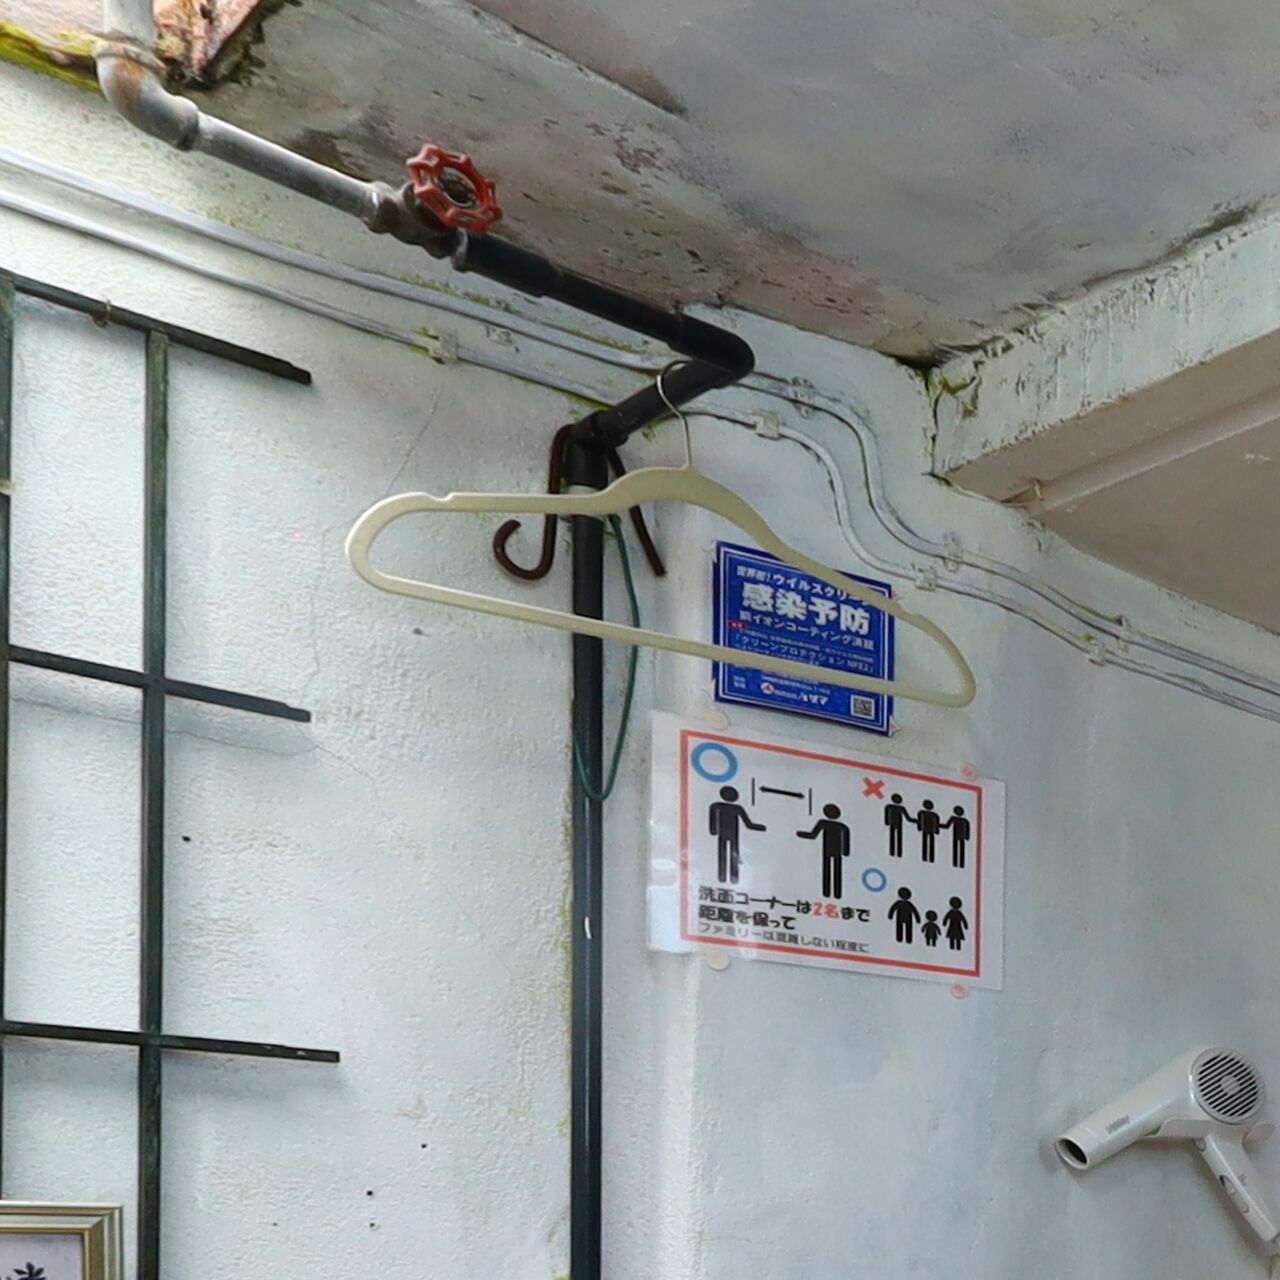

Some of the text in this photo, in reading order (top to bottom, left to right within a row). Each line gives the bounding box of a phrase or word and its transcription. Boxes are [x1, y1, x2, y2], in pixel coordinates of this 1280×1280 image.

[742, 582, 870, 636] 感染予防
[698, 905, 796, 931] 距離を保って
[699, 885, 871, 922] 洗面コーナーは2名まで
